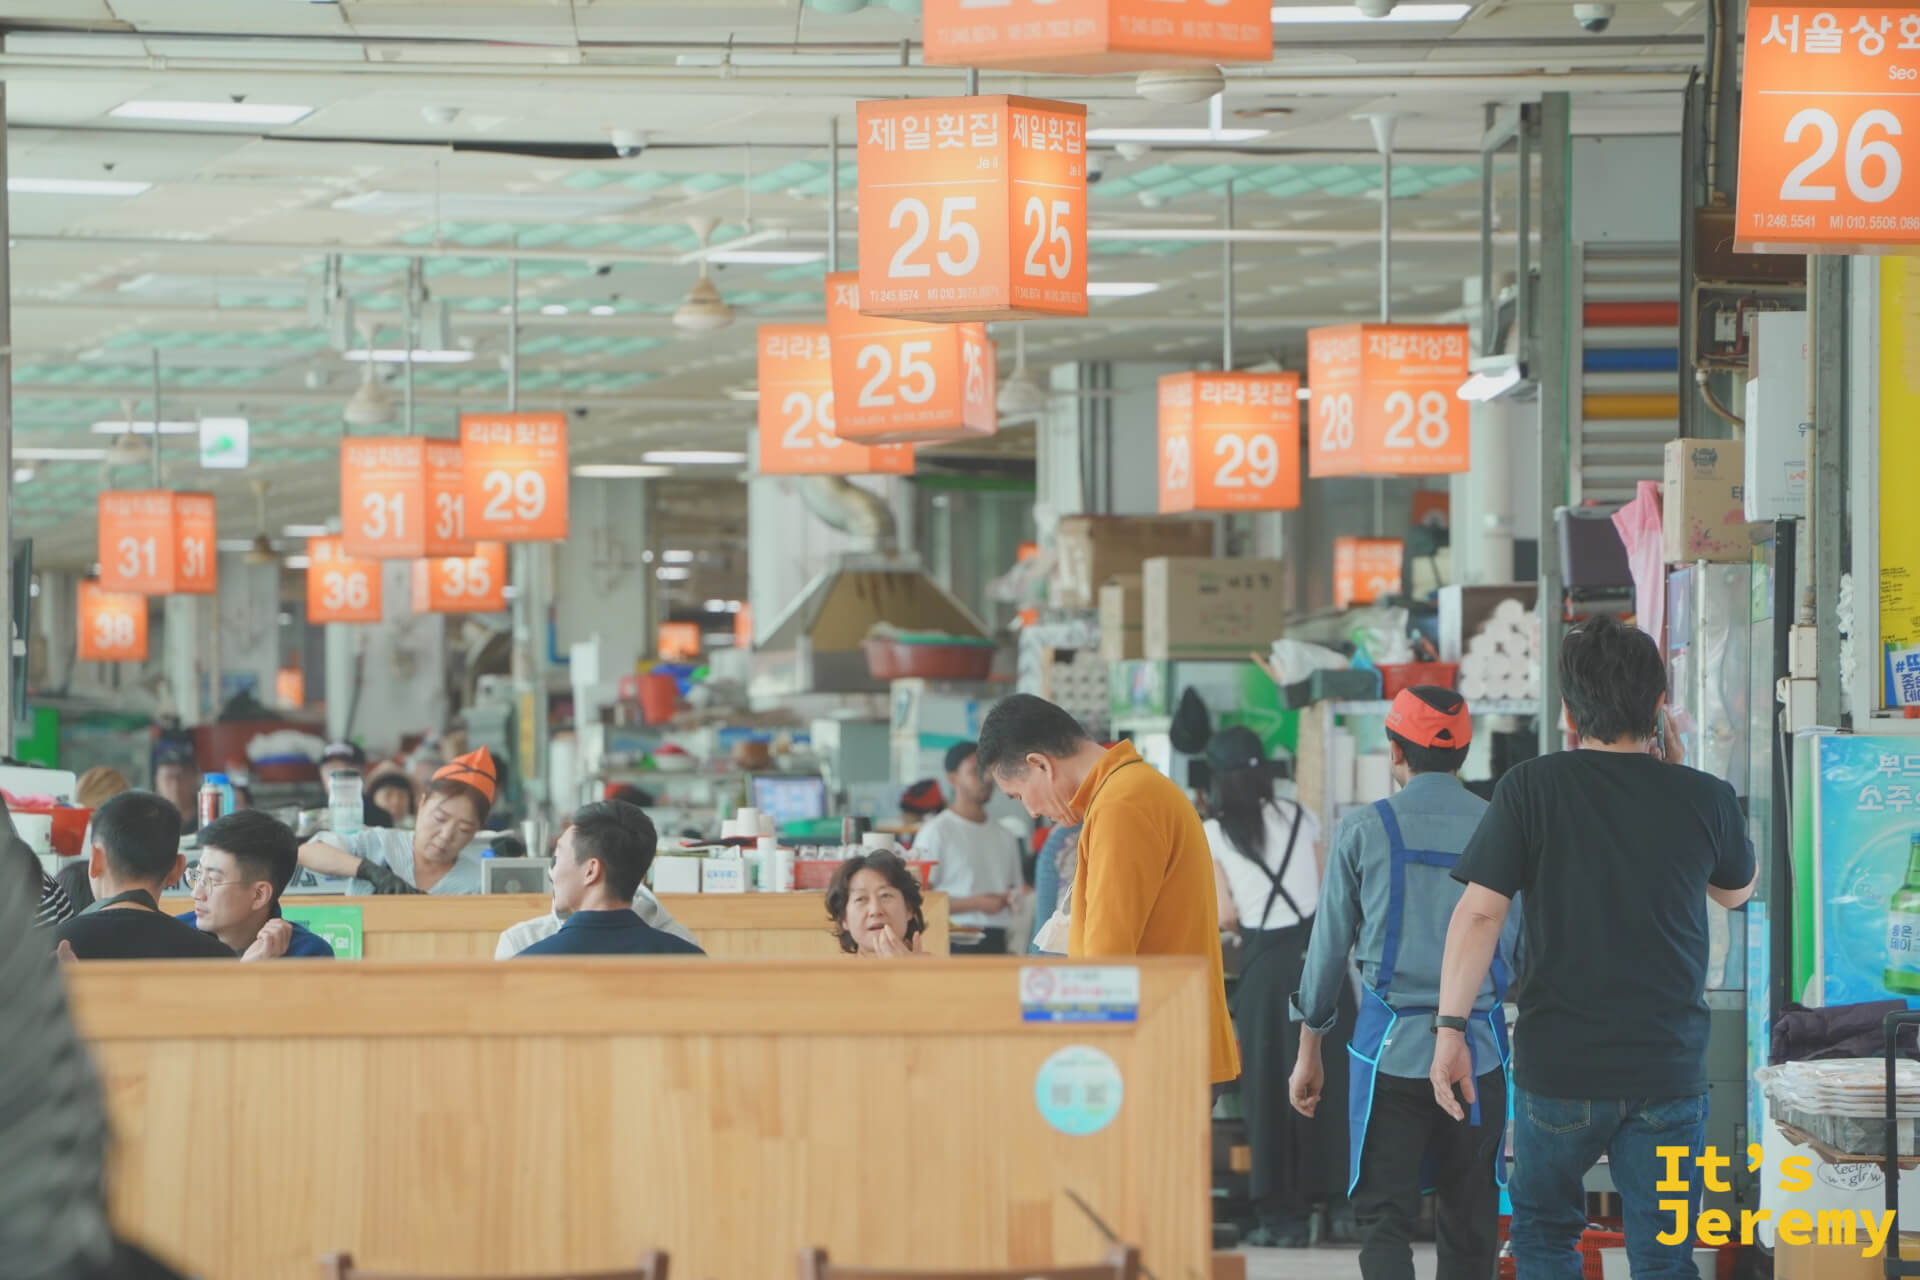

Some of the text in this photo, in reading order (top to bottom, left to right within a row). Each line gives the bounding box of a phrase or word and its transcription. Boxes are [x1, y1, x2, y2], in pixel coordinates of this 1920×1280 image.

[1889, 65, 1918, 80] Seo
[867, 113, 998, 152] 제일횟집
[1013, 113, 1081, 154] 제일횟집
[1780, 108, 1903, 203] 26
[888, 197, 980, 278] 25
[1024, 197, 1072, 280] 25
[1368, 335, 1463, 360] 자갈치상회
[856, 341, 936, 407] 25
[963, 340, 984, 405] 25
[1320, 393, 1353, 450] 28
[1384, 391, 1450, 448] 28
[1166, 434, 1190, 490] 29
[1214, 434, 1279, 488] 29
[362, 491, 406, 540] 31
[436, 491, 465, 540] 31
[482, 469, 546, 520] 29
[117, 535, 158, 579] 31
[182, 536, 206, 579] 31
[442, 557, 492, 597] 35
[322, 571, 369, 609] 36
[1856, 783, 1920, 813] 소주
